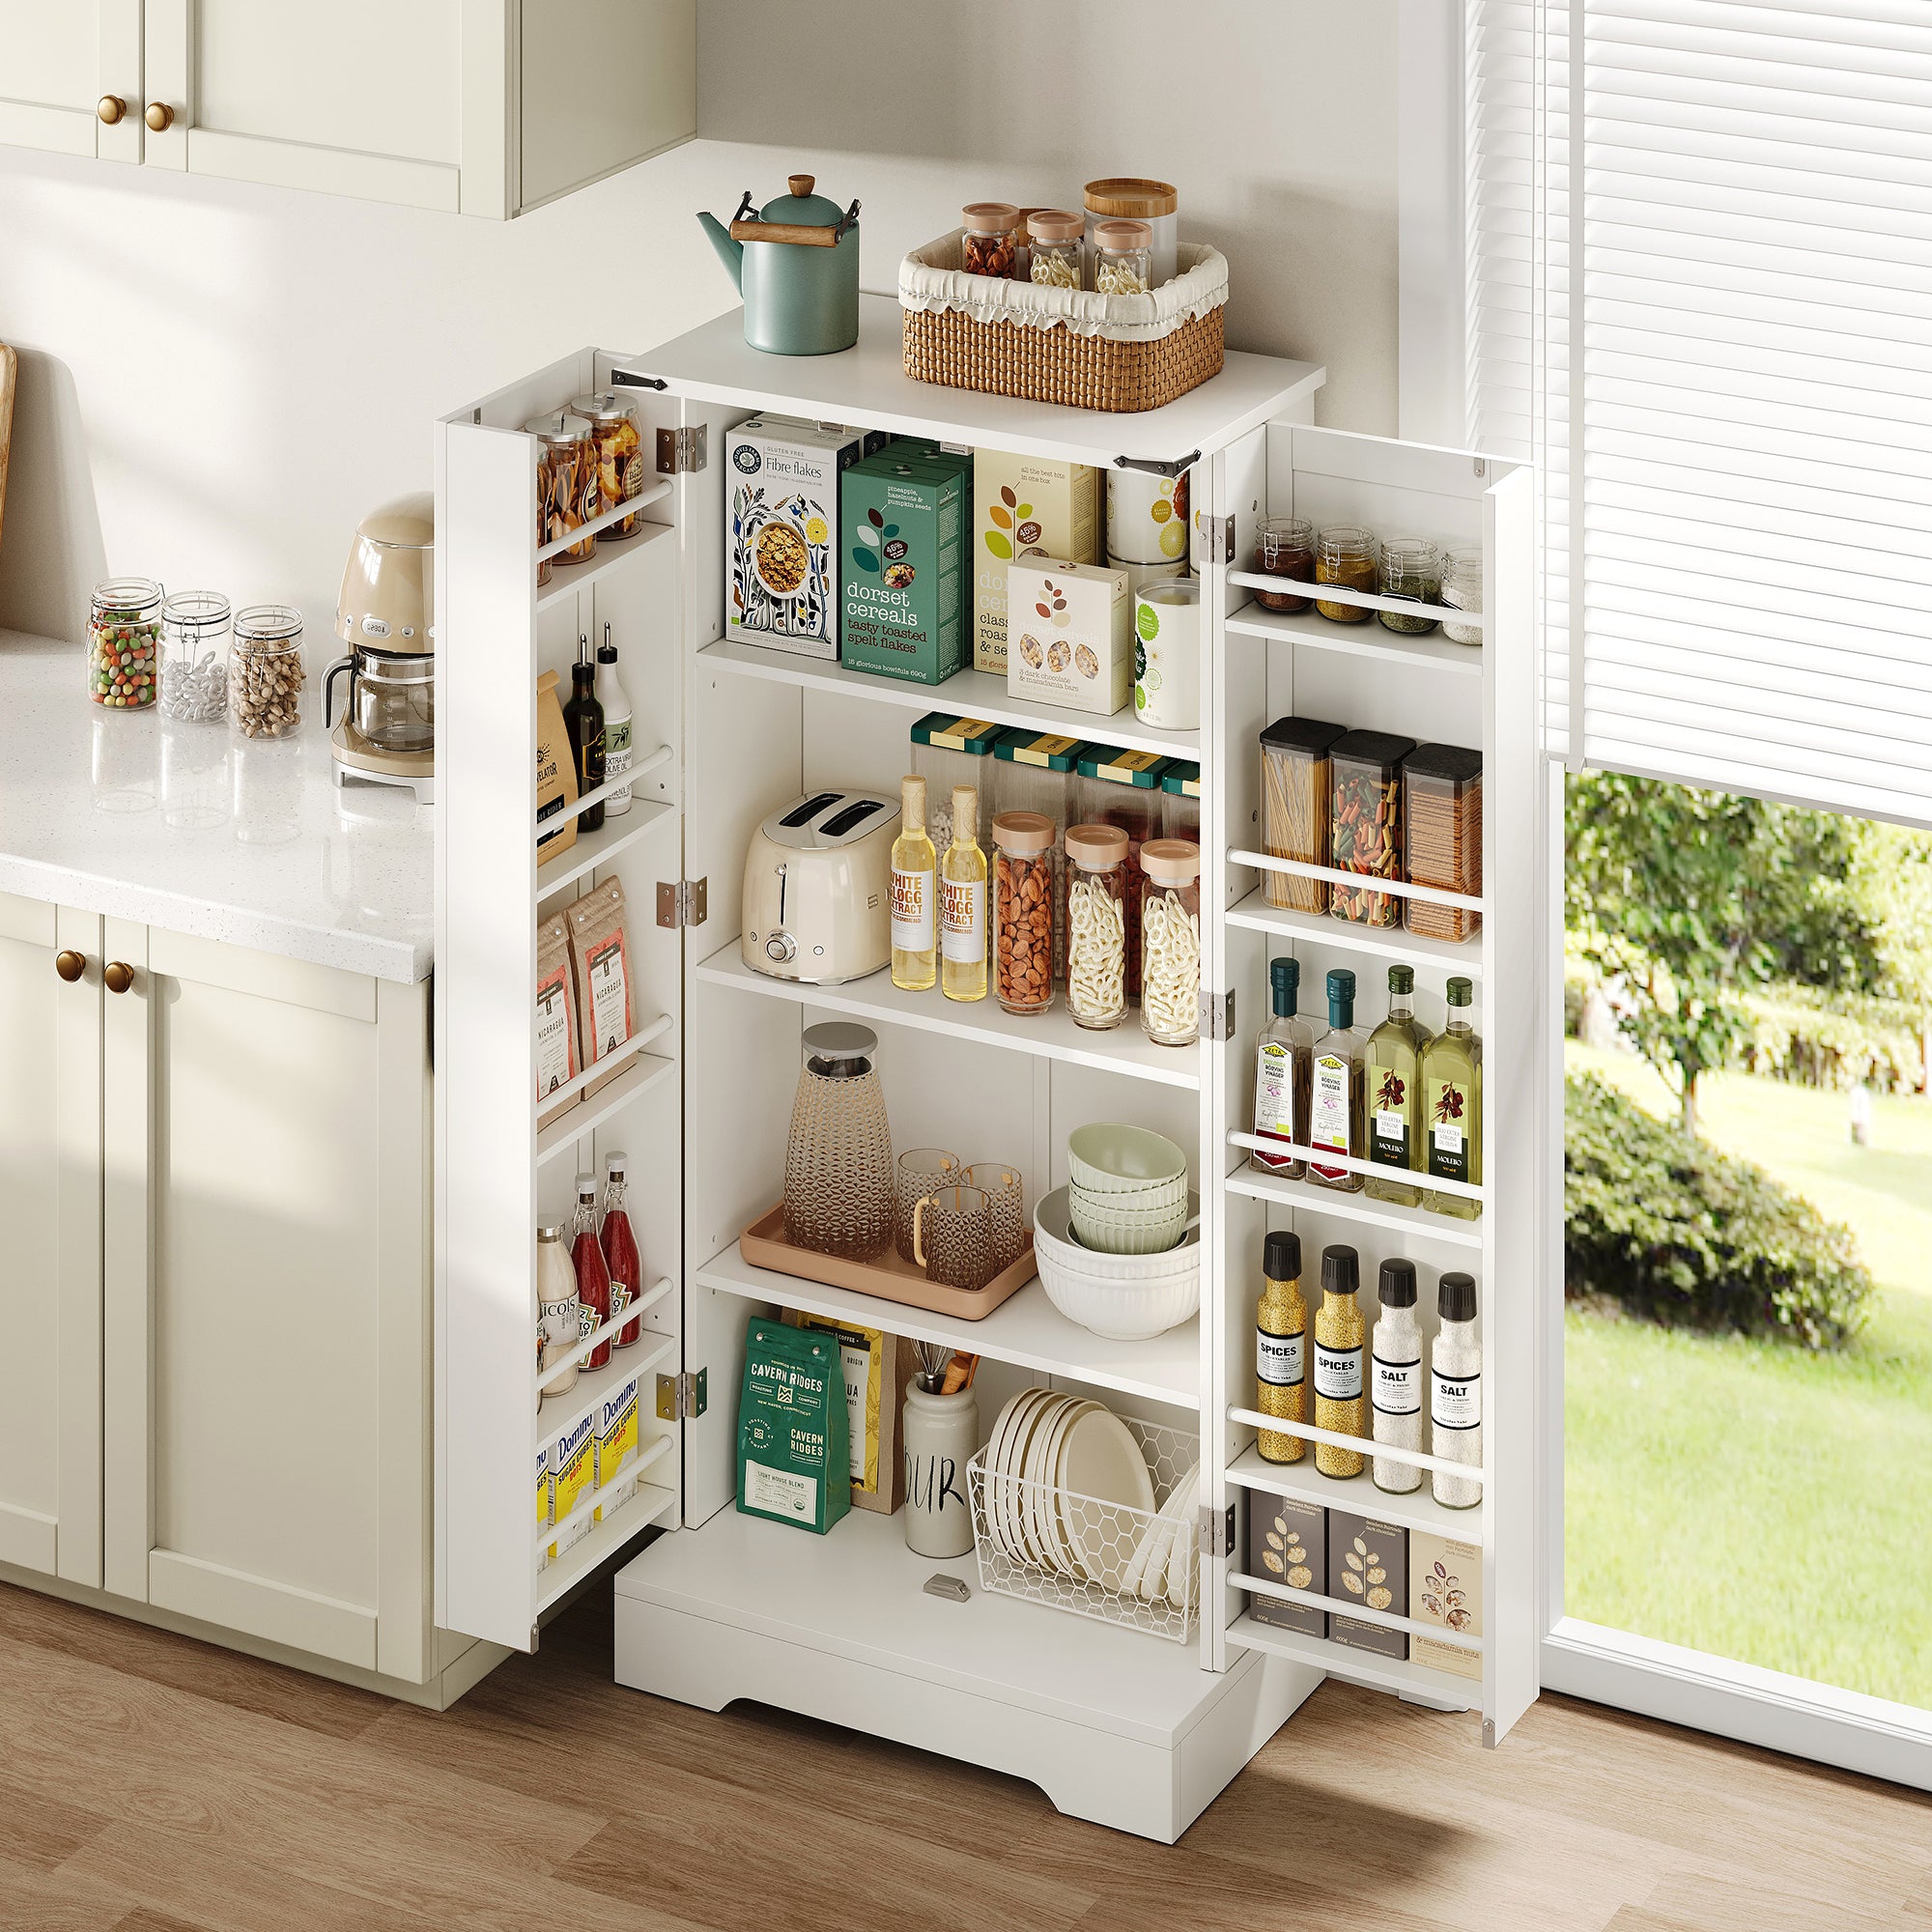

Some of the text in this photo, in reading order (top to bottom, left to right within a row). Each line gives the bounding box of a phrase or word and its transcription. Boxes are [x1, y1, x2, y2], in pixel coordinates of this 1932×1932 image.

[767, 446, 789, 455] GLUTEN
[766, 457, 822, 479] Fibre flakes
[1030, 468, 1040, 476] the
[1039, 476, 1051, 485] box
[887, 493, 917, 502] hazelnuts
[887, 498, 915, 509] pumpkin
[847, 582, 910, 608] dorset
[847, 602, 918, 626] cereals
[847, 618, 927, 642] tasty toasted
[847, 633, 878, 647] spelt
[880, 638, 917, 654] flakes
[980, 640, 991, 652] &
[856, 660, 882, 670] glorious
[882, 665, 909, 675] bowlfuls
[1024, 670, 1039, 679] dark
[1041, 673, 1071, 684] chocolate
[1026, 677, 1064, 689] macadamia
[605, 756, 622, 765] EXTRA
[605, 764, 620, 773] OLIVE
[596, 978, 622, 1000] NICARAGUA
[538, 1017, 564, 1039] NICARAGUA
[1388, 1116, 1402, 1124] EXTRA
[1261, 1342, 1297, 1356] SPICES
[846, 1356, 864, 1367] ORIGIN
[1319, 1356, 1355, 1371] SPICES
[751, 1363, 823, 1393] CAVERN RIDGES
[1380, 1370, 1407, 1382] SALT
[1440, 1384, 1467, 1397] SALT
[602, 1378, 637, 1428] Domino
[798, 1396, 818, 1406] COMPANY
[603, 1423, 620, 1450] SUGAR
[620, 1402, 637, 1428] CUBES
[557, 1413, 593, 1463] Domino
[790, 1428, 824, 1445] CAVERN
[790, 1439, 823, 1457] RIDGES
[557, 1436, 593, 1486] SUGAR CUBES
[757, 1470, 805, 1490] LIGHT HOUSE BLEND
[1416, 1635, 1480, 1660] & macadamia nuts
